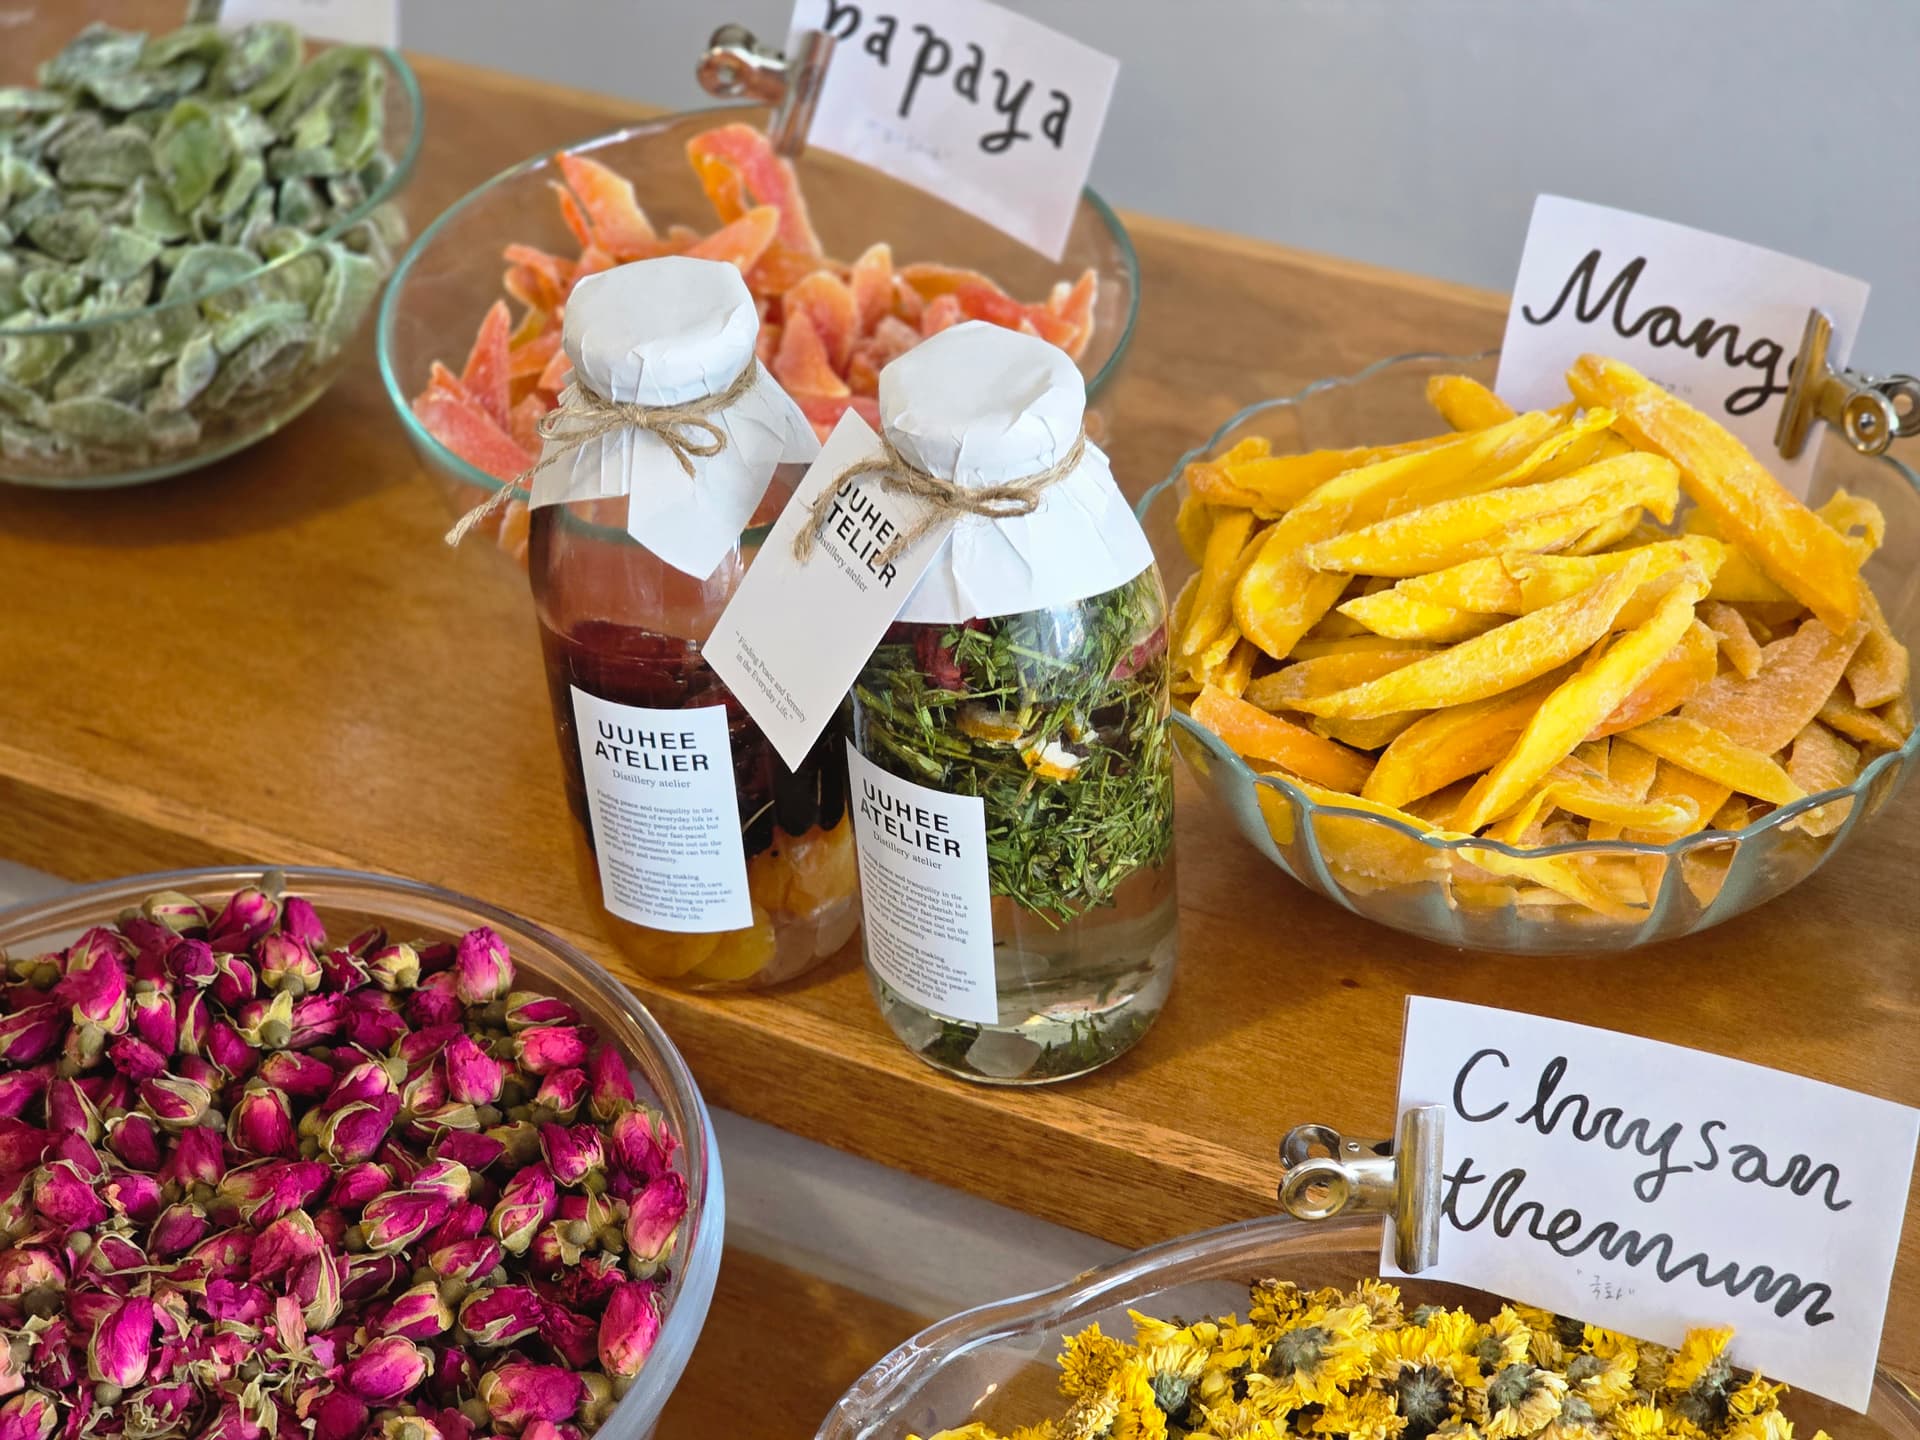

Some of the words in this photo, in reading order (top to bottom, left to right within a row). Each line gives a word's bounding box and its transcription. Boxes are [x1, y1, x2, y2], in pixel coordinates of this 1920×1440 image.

[1522, 249, 1798, 415] Mang
[818, 500, 896, 588] TELIER
[845, 566, 868, 592] atelier
[751, 670, 777, 703] Everyday
[598, 719, 697, 750] UUHEE
[595, 740, 709, 772] ATELIER
[612, 769, 656, 788] Distillery
[659, 776, 691, 788] atelier
[863, 778, 949, 834] UUHEE
[861, 798, 961, 858] ATELIER
[873, 830, 910, 859] Distillery
[912, 854, 942, 869] atelier
[1453, 1048, 1852, 1212] Chrysan
